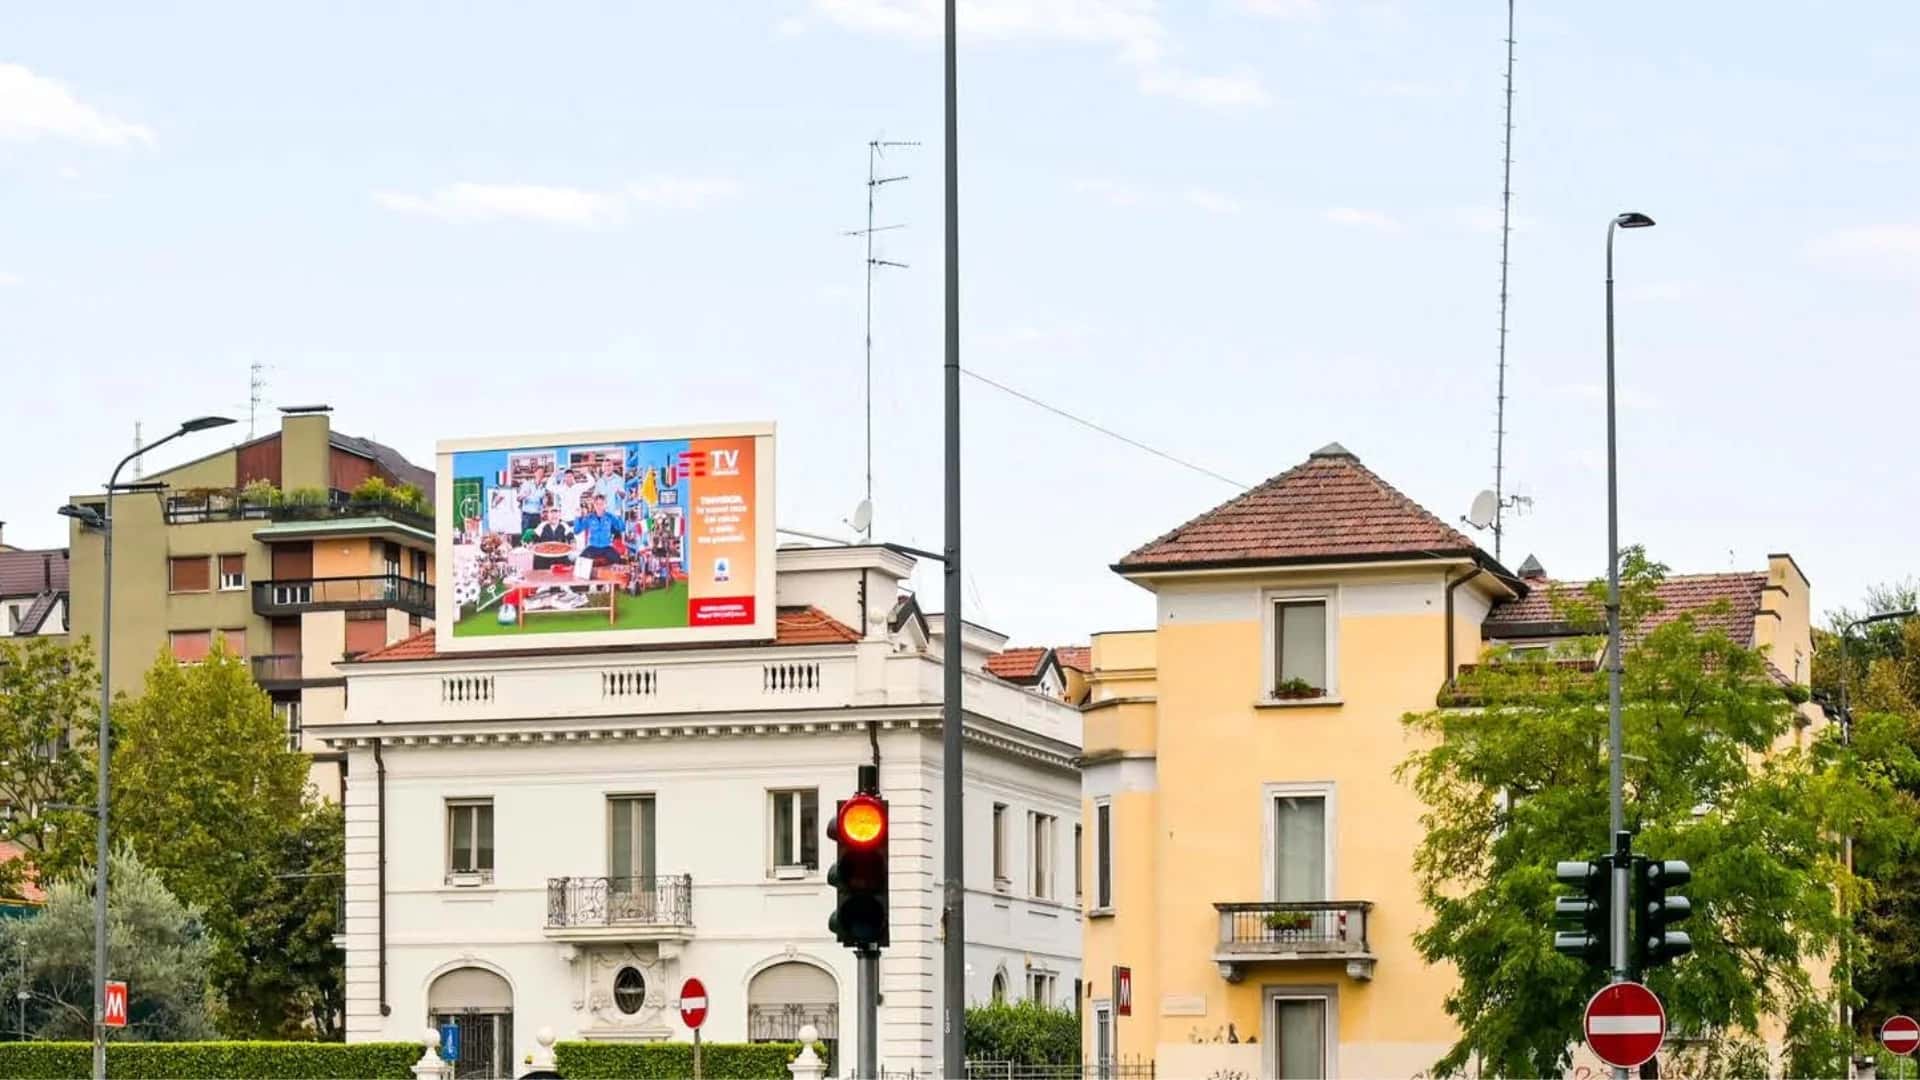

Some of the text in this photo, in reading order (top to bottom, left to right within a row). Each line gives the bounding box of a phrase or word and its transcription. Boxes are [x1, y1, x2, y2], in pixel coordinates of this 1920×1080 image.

[710, 449, 739, 472] TV
[106, 991, 124, 1017] M
[1120, 977, 1130, 1007] M
